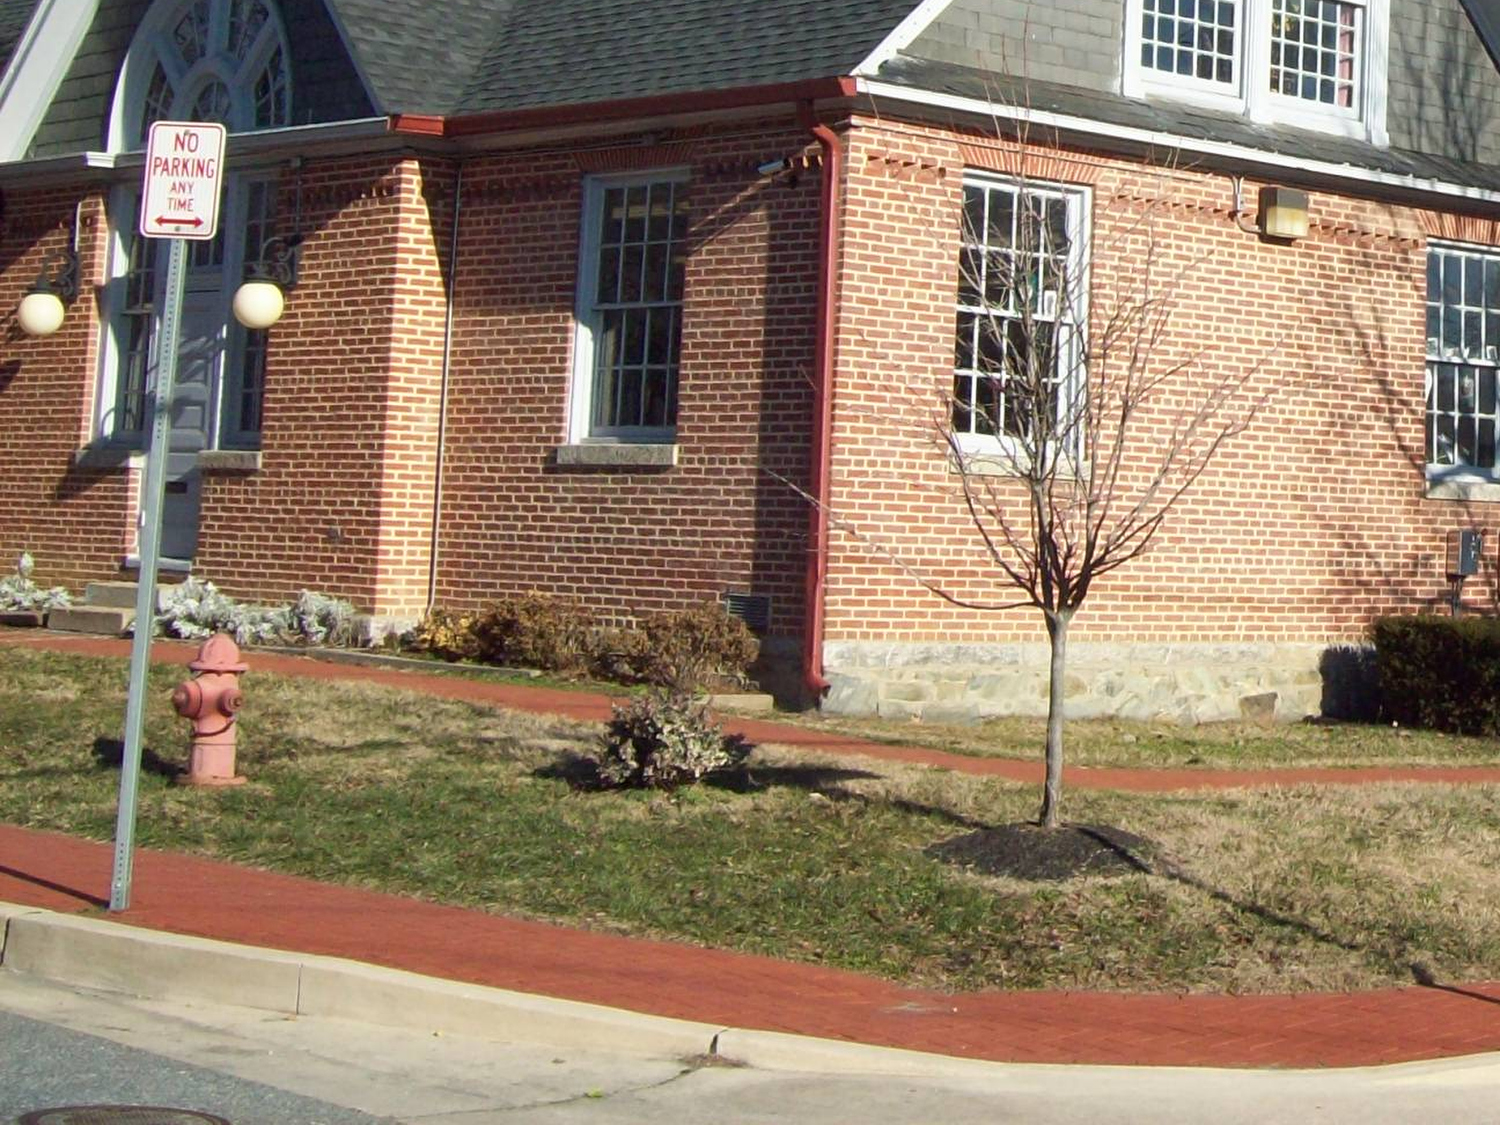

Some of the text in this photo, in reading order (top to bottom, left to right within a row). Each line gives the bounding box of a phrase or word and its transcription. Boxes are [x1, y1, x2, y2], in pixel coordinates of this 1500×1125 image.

[174, 132, 199, 153] NO
[153, 156, 215, 179] PARKING
[170, 181, 195, 194] ANY
[167, 197, 194, 212] TIME
